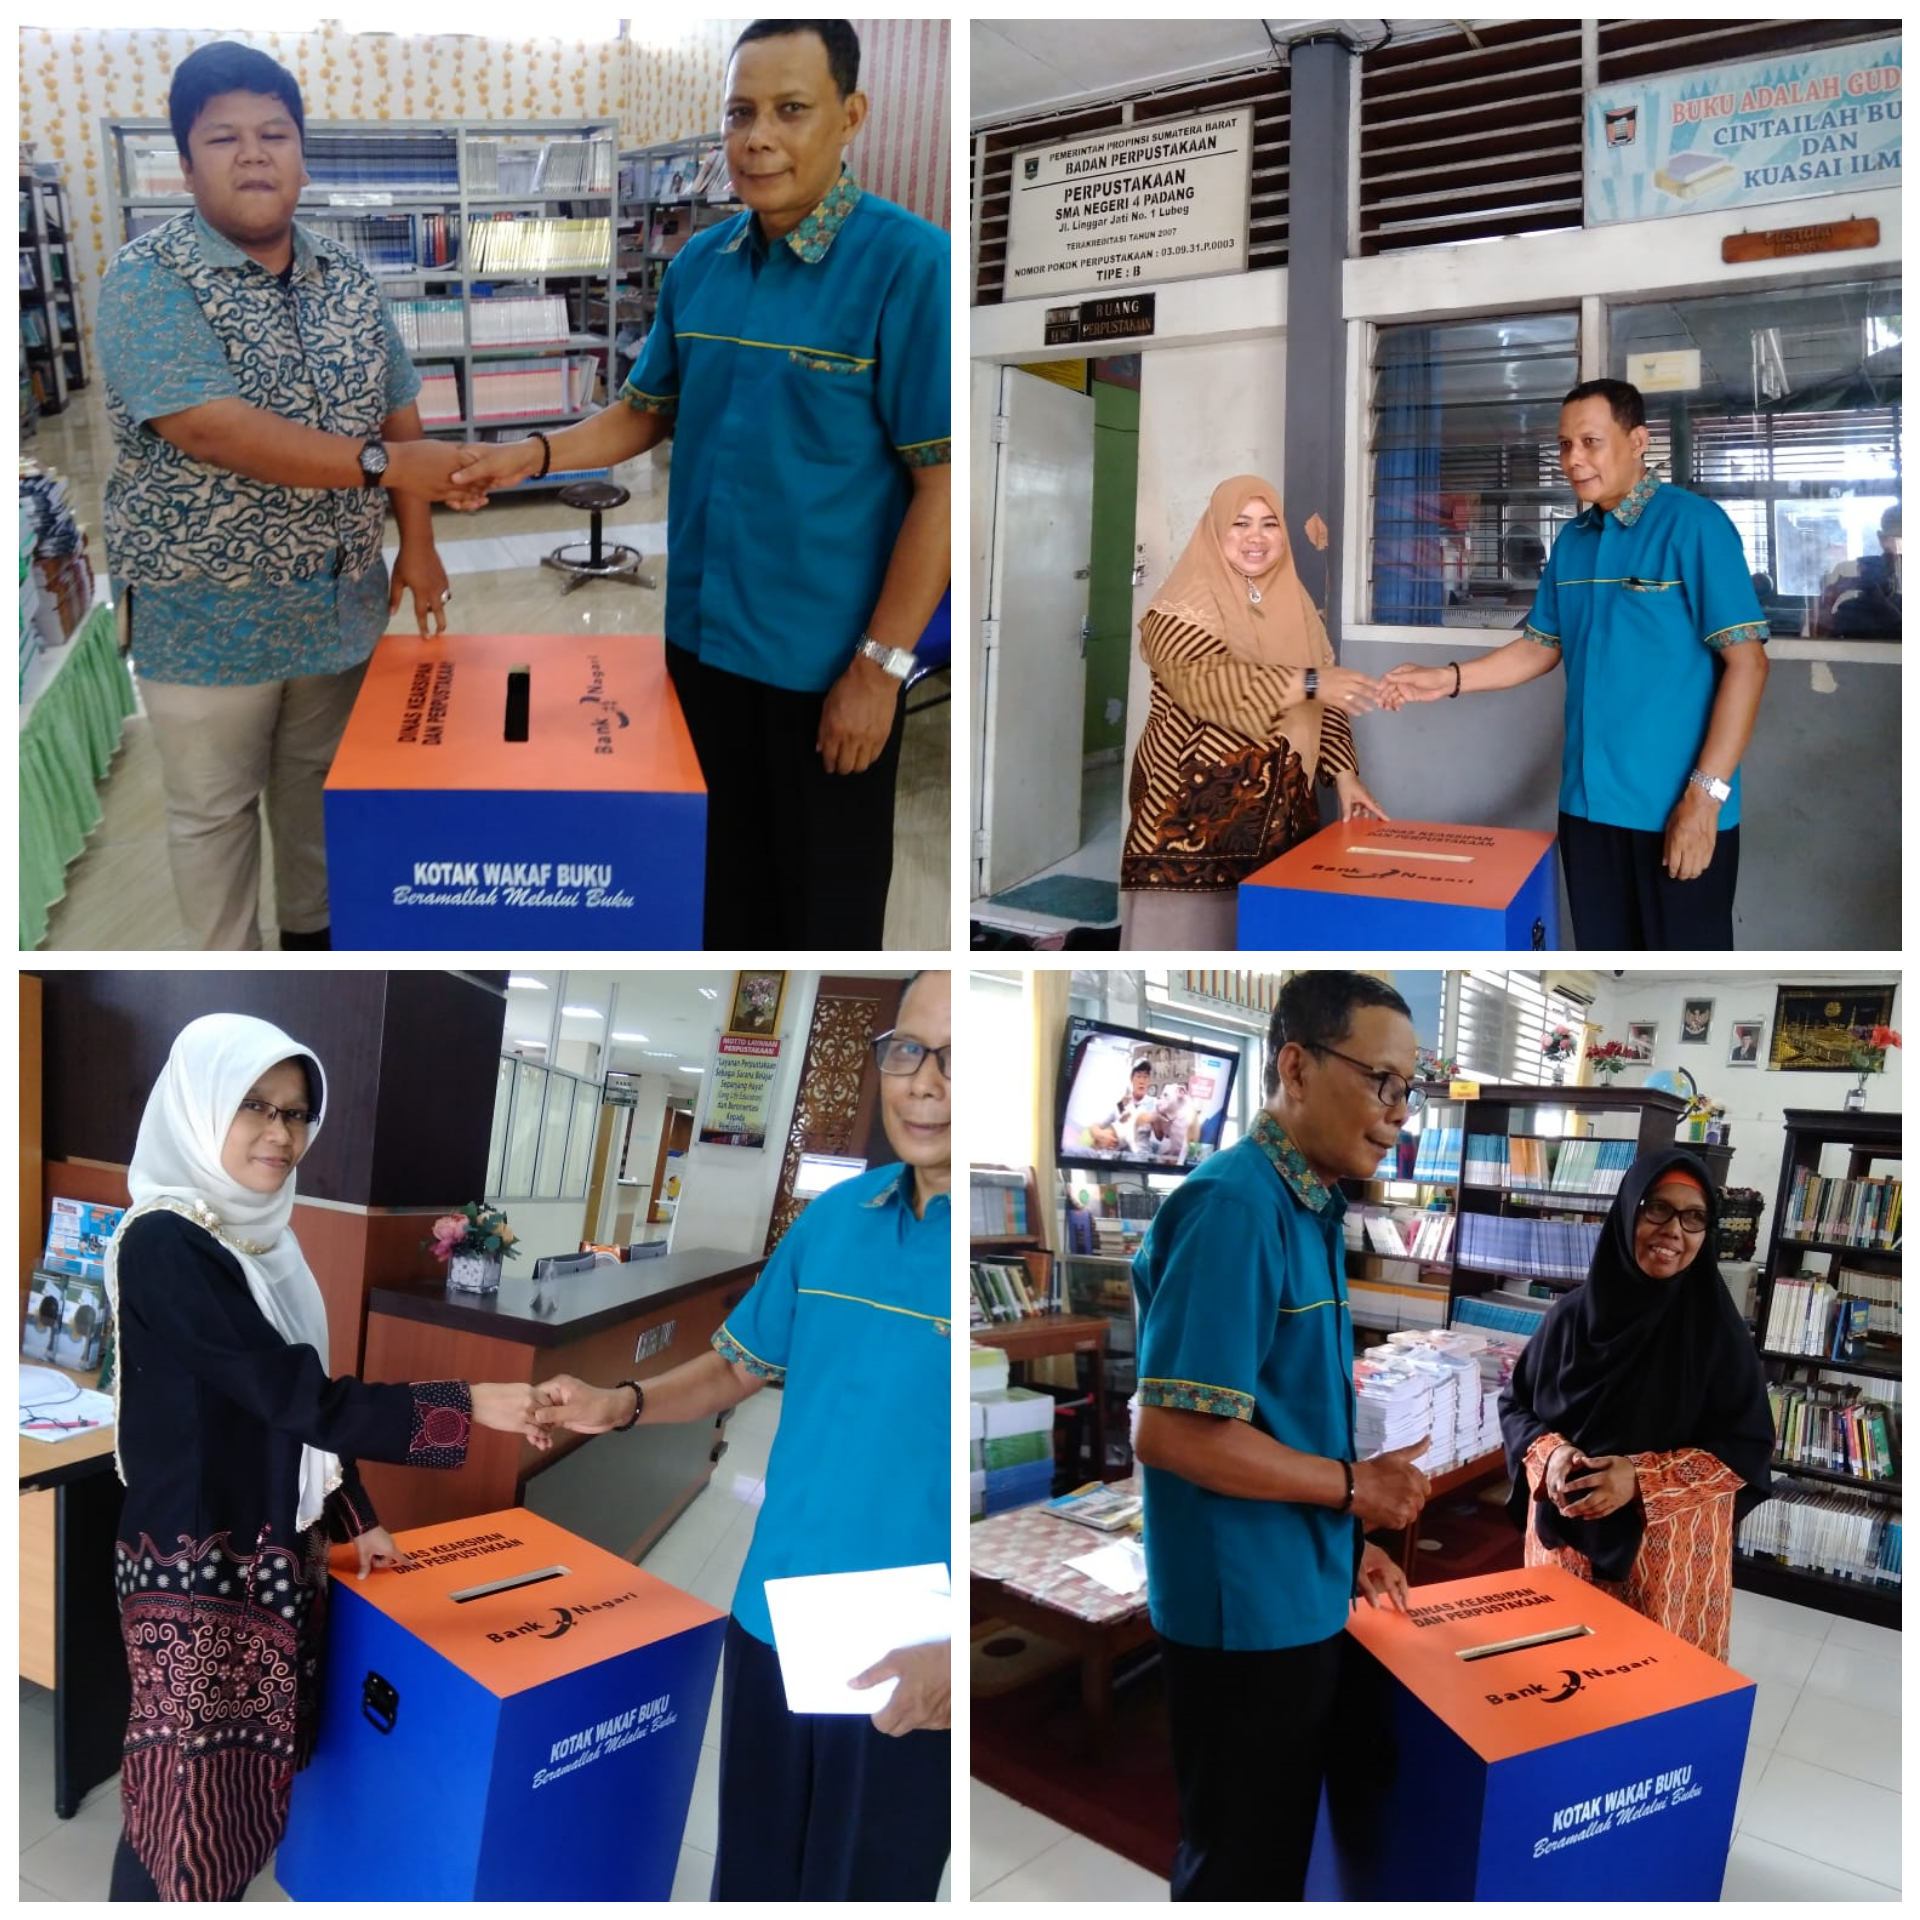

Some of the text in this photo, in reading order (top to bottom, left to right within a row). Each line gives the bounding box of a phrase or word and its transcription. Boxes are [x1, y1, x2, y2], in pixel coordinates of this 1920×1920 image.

[1670, 92, 1734, 125] BUKU
[1740, 78, 1840, 113] ADALAH
[1049, 118, 1238, 162] PEMERINTAH PROPINSI SUMATERA BARAT
[1713, 100, 1902, 146] CINTAILAH BU
[1066, 135, 1217, 175] BADAN PERPUSTAKAAN
[1801, 131, 1857, 157] DAN
[1064, 168, 1186, 203] PERPUSTAKAAN
[1743, 150, 1902, 189] KUASAI ILM
[1055, 186, 1195, 220] SMA NEGERI 4 PADANG
[1072, 218, 1107, 231] Linggar
[1110, 213, 1128, 225] Jati
[1131, 211, 1147, 222] No.
[1151, 209, 1155, 218] 1
[1159, 205, 1190, 217] Lubeg
[1066, 228, 1178, 250] TERAKREDITASI TAHUN 2007
[1014, 264, 1045, 277] NOMOR
[1047, 260, 1077, 273] POKOK
[1080, 249, 1154, 268] PERPUSTAKAAN
[1096, 268, 1123, 281] TIPE
[1132, 266, 1141, 277] B
[1096, 300, 1140, 318] RUANG
[586, 655, 613, 754] Bank Nagari
[398, 712, 422, 742] DINAS
[422, 726, 443, 745] DAN
[413, 862, 612, 888] KOTAK WAKAF BUKU
[1310, 863, 1474, 884] Bank Nagari
[393, 885, 635, 908] Beramallah Melalui Buku
[722, 1037, 747, 1046] MOTTO
[723, 1045, 775, 1054] PERPUSTAKAAN
[392, 1538, 524, 1575] DAN PERPUSTAKAAN
[428, 1532, 506, 1554] KEARSIPAN
[485, 1591, 639, 1644] Bank Nagari
[1406, 1588, 1537, 1618] DINAS KEARSIPAN
[1411, 1594, 1556, 1628] DAN PERPUSTAKAAN
[1484, 1656, 1659, 1705] Bank Nagari
[550, 1694, 670, 1763] KOTAK WAKAF BUKU
[532, 1710, 678, 1789] Beramallah Melalui Buku
[1552, 1764, 1693, 1833] KOTAK WAKAF BUKU
[1533, 1782, 1703, 1858] Beramallah Melalui Buku
